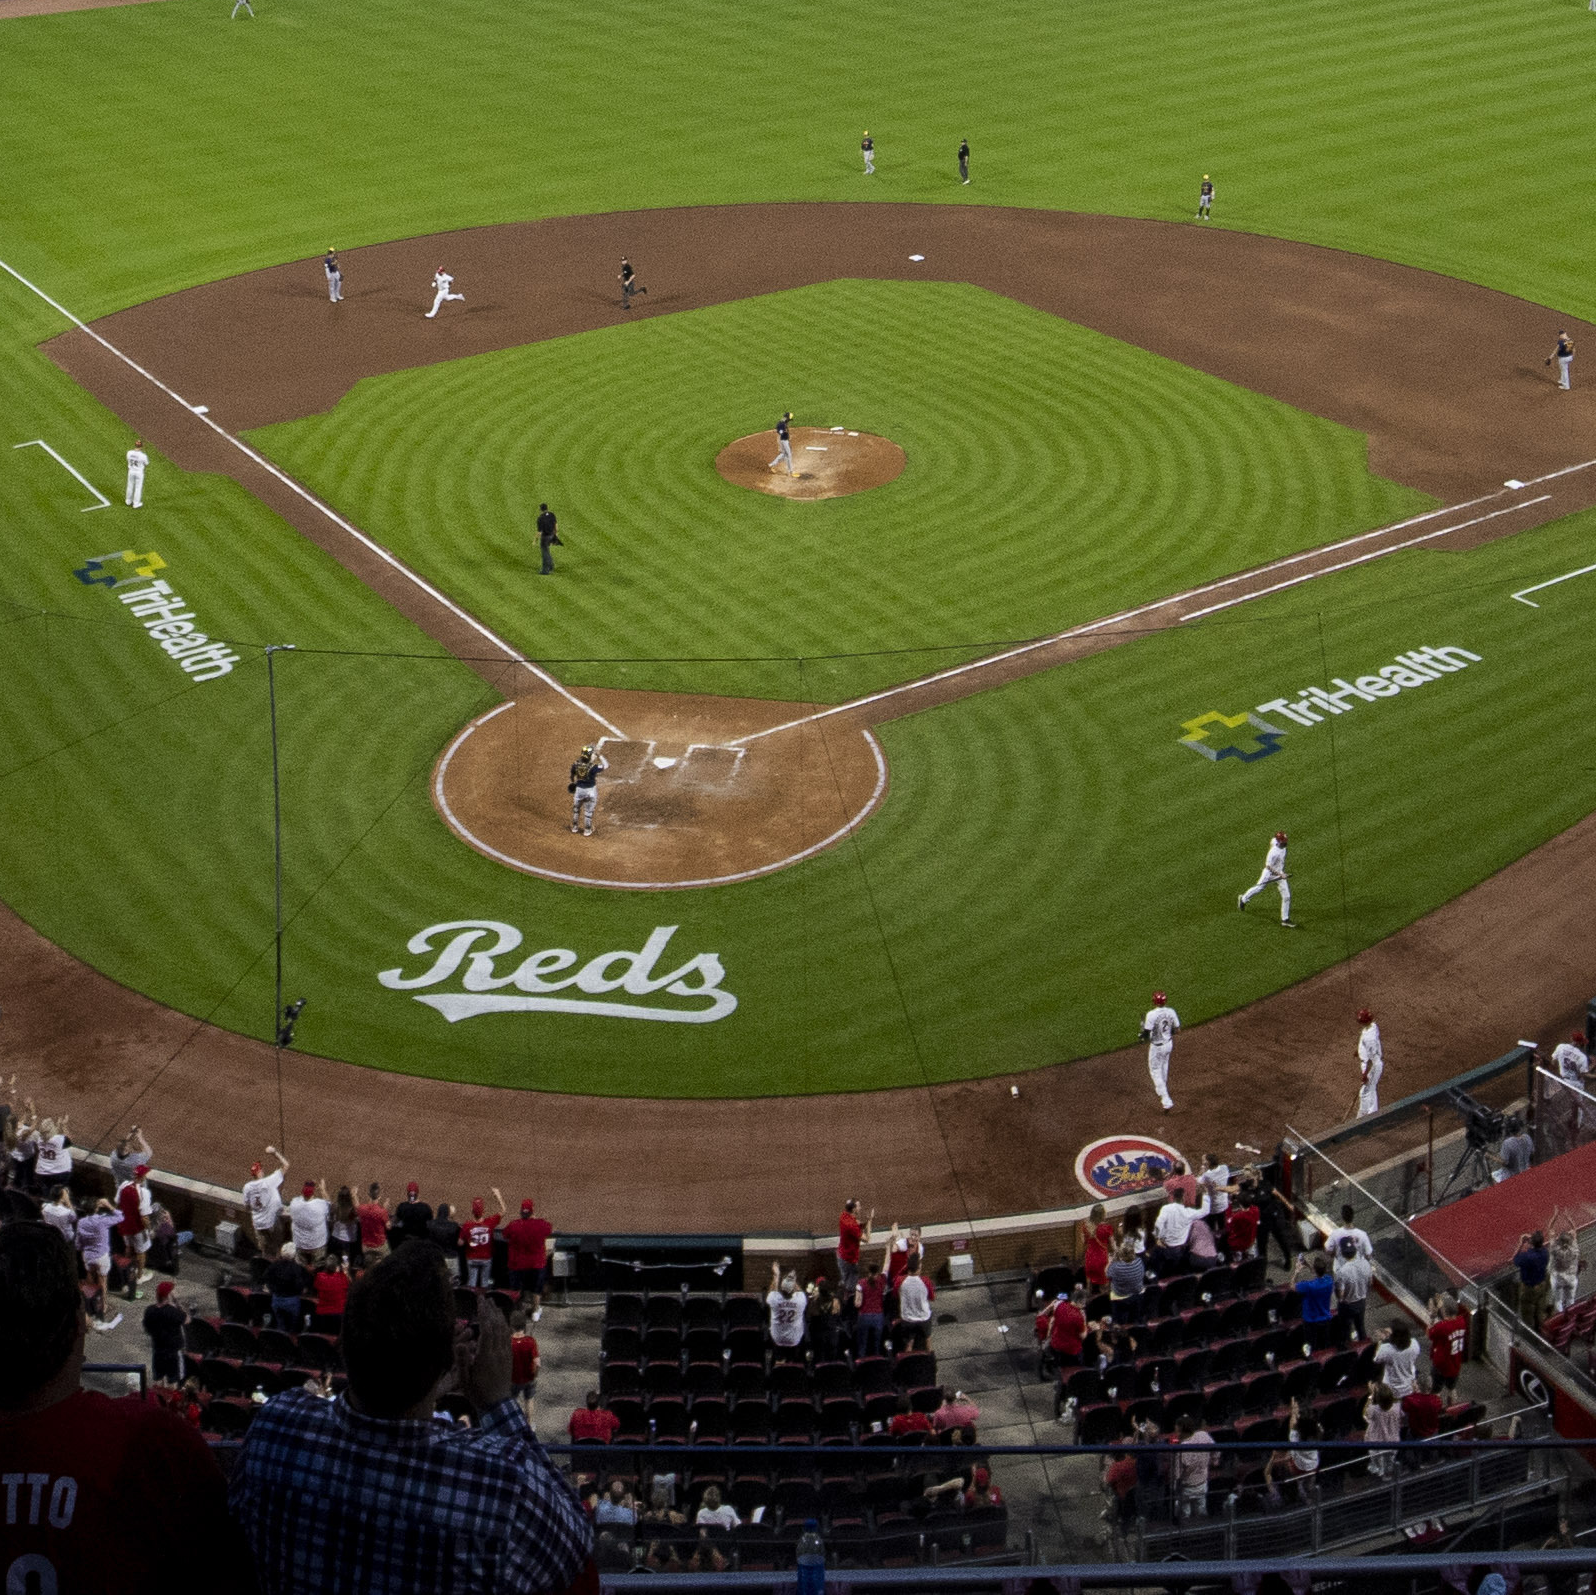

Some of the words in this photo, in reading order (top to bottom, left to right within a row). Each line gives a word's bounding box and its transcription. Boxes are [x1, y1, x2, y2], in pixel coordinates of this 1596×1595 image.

[117, 579, 242, 684] TriHealth
[1254, 645, 1484, 727] TriHealth
[377, 919, 739, 1023] Reds
[777, 1309, 796, 1324] 22
